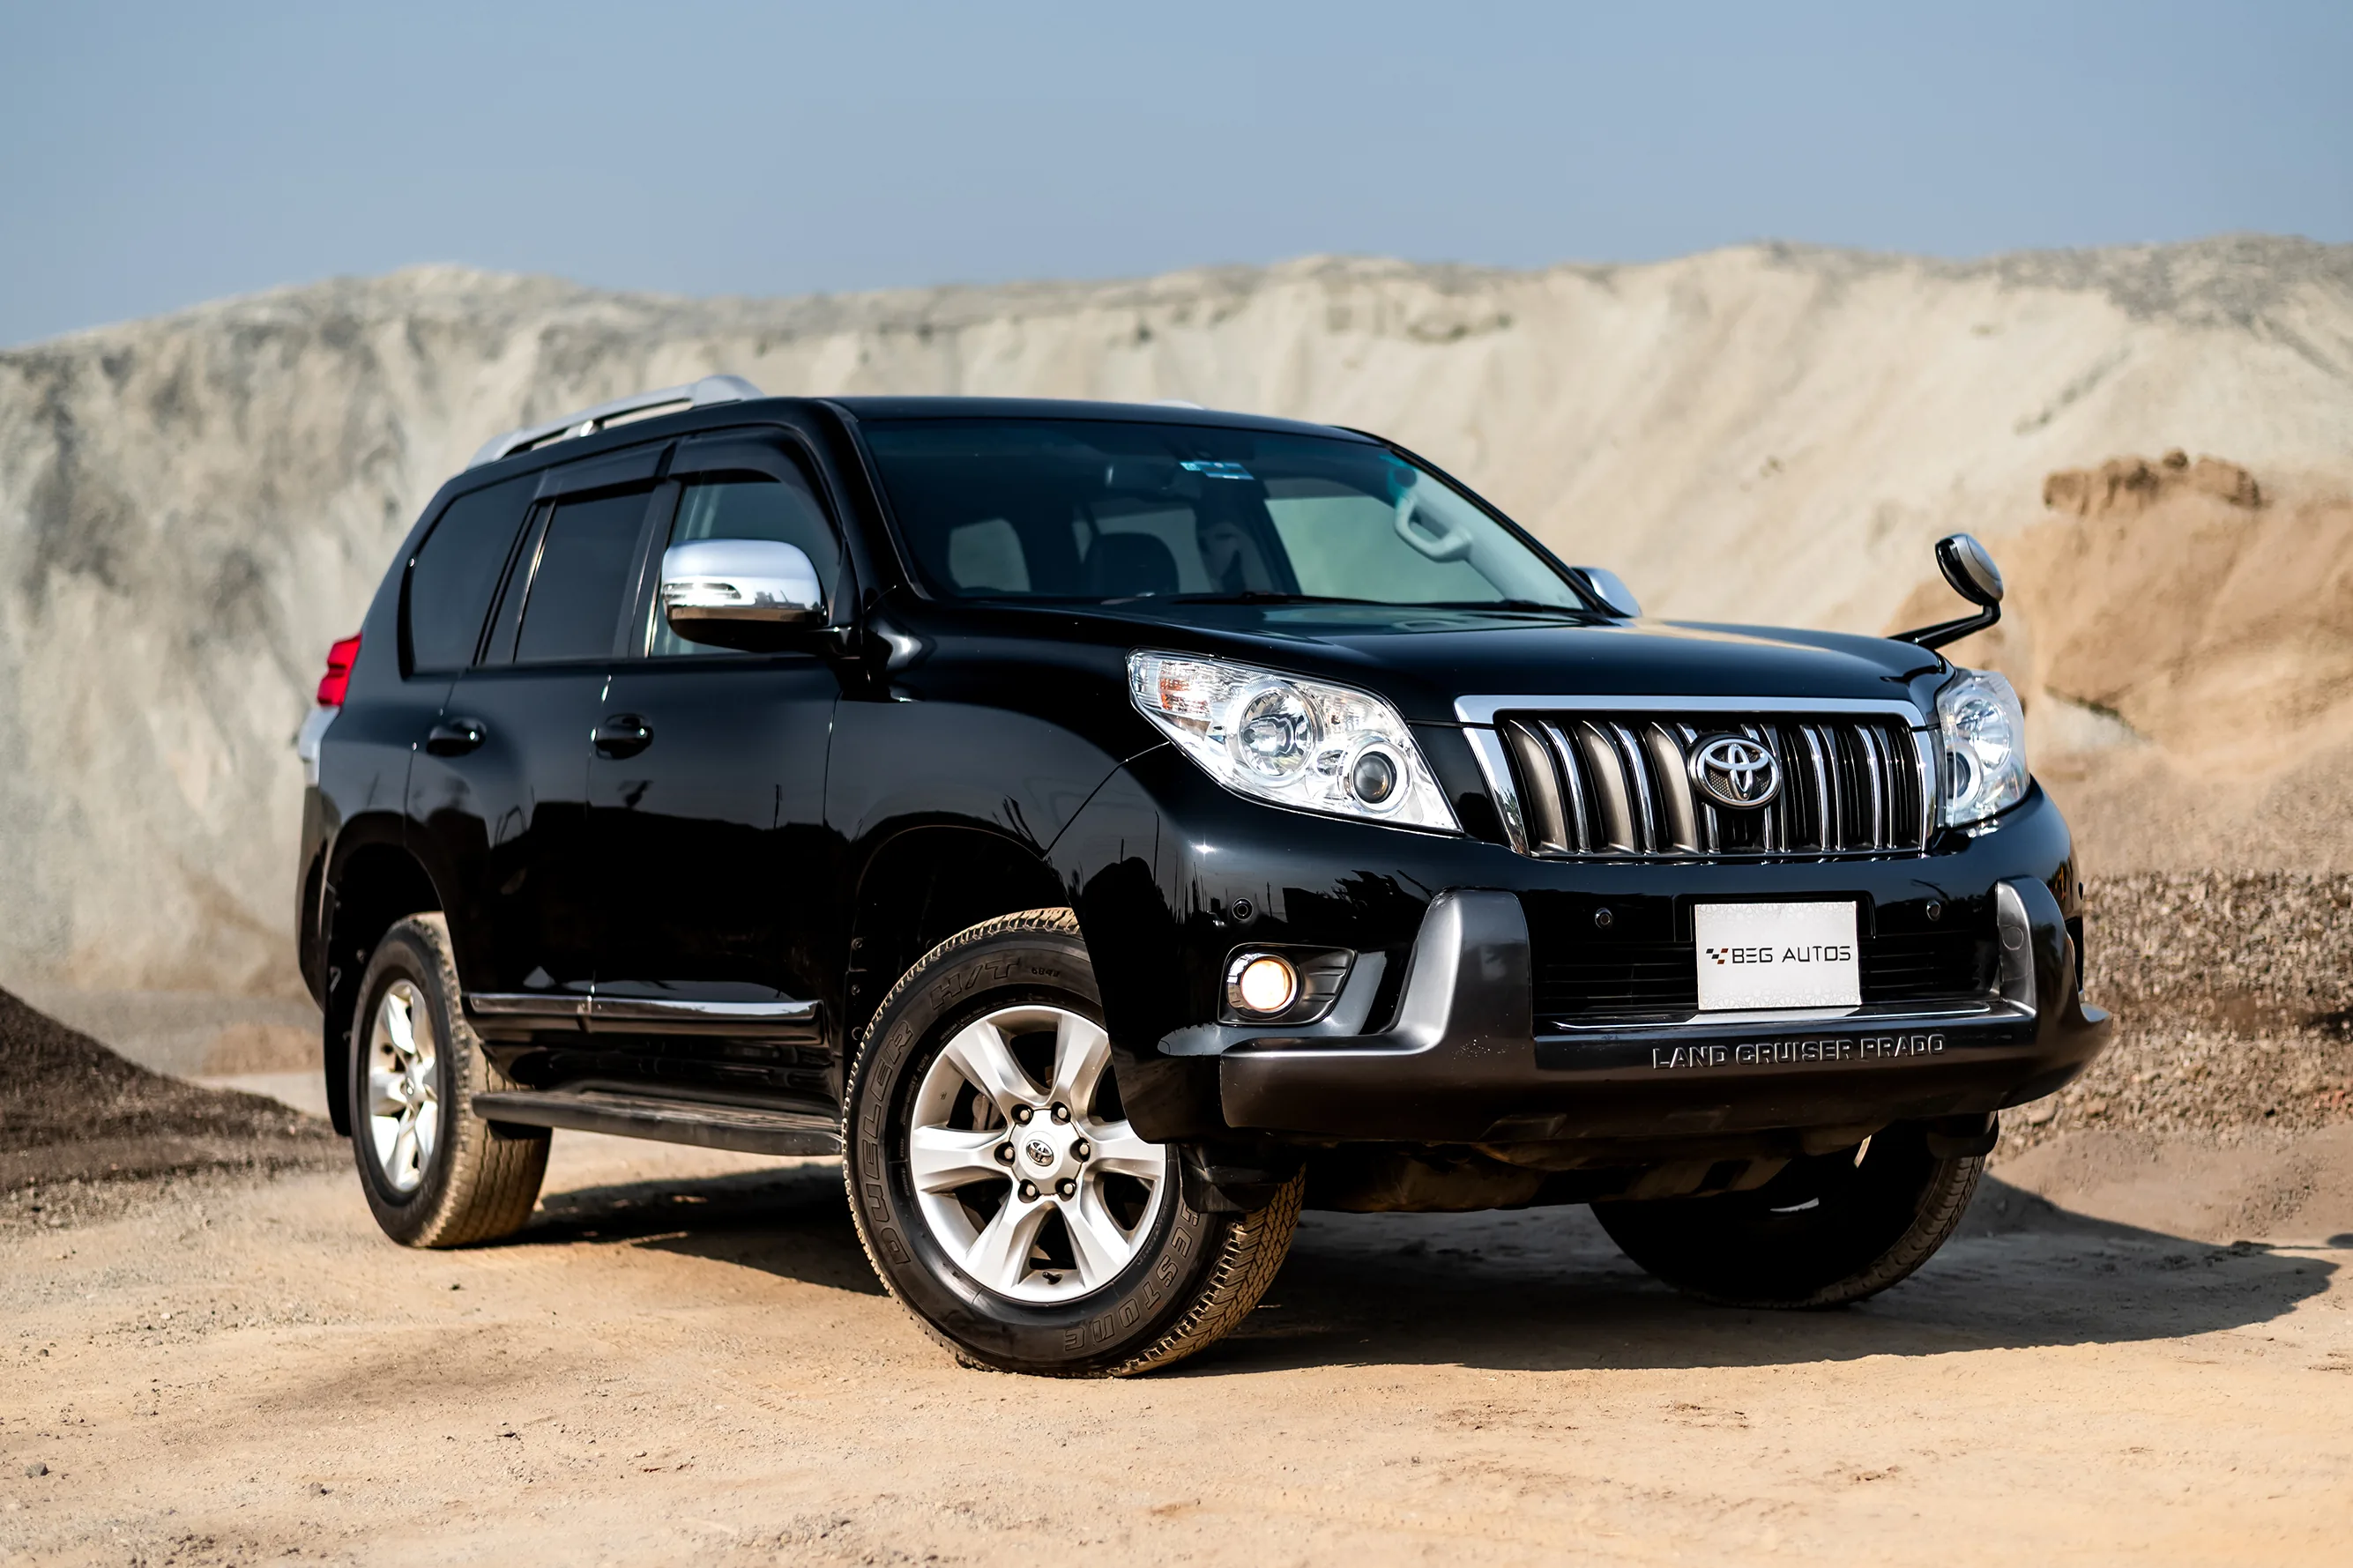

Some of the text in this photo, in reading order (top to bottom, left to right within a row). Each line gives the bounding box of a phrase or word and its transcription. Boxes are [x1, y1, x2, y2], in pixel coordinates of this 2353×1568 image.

[1732, 946, 1851, 963] BEG AUTOS
[1652, 1034, 1946, 1069] LAND CRUISER PRADO
[861, 1021, 914, 1264] DUELER
[930, 957, 1020, 1010] H/T
[1065, 1201, 1201, 1351] GESTONE
